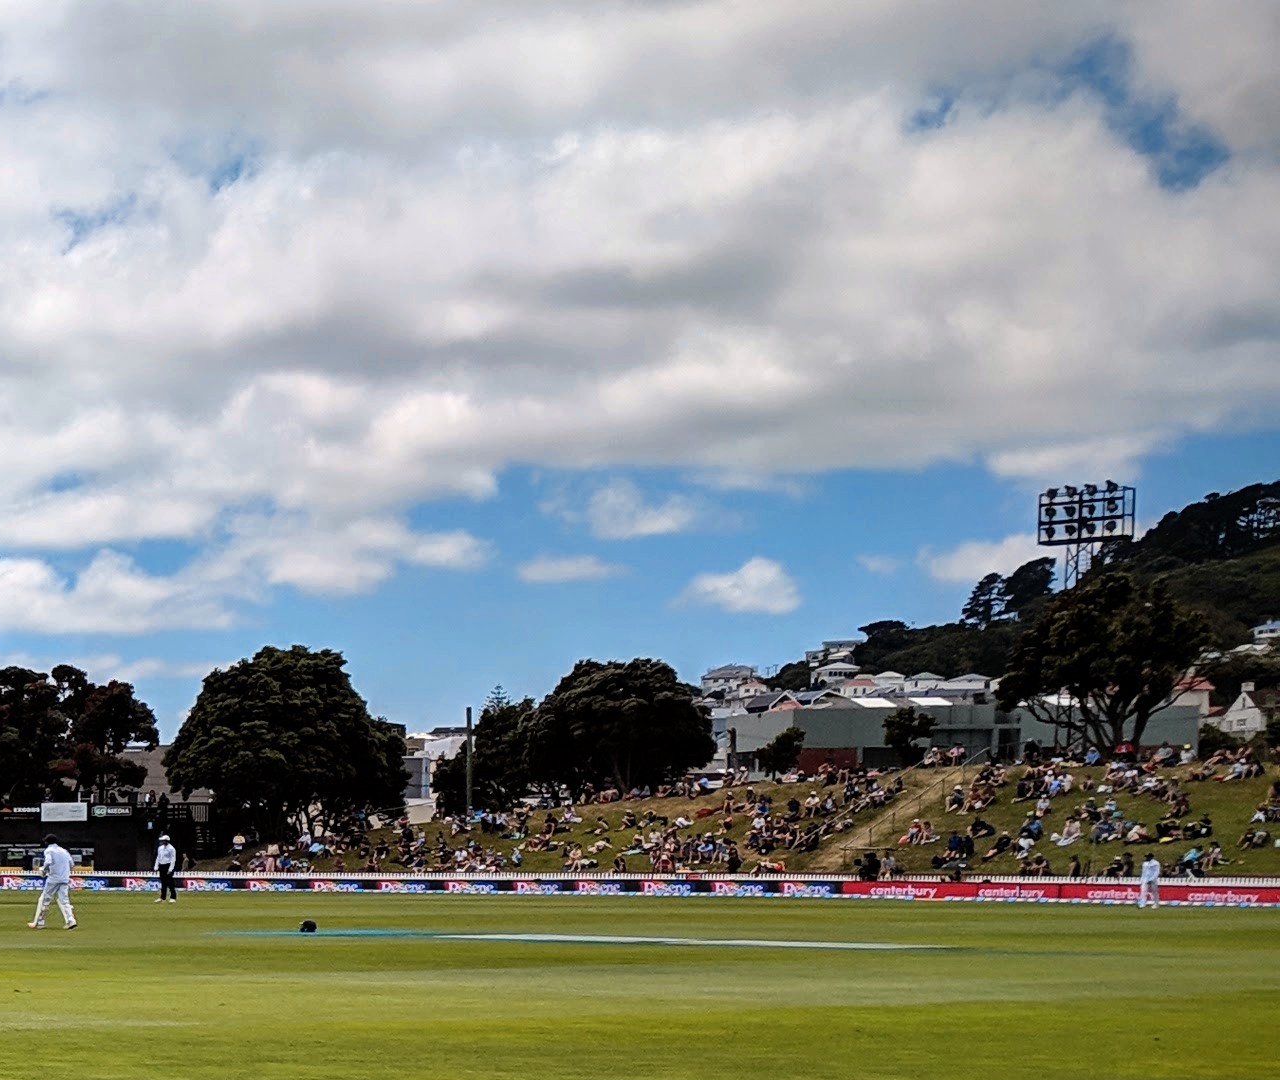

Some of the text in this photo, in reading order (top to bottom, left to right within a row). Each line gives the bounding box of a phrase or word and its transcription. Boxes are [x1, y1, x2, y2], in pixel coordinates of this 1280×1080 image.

[3, 876, 43, 887] Resene
[126, 878, 161, 889] Resen
[186, 879, 228, 890] Resene
[249, 880, 292, 891] Resene
[313, 880, 358, 892] Resene
[381, 881, 426, 892] Resene
[448, 881, 494, 893] Resene
[516, 881, 559, 893] Resene
[578, 881, 621, 893] Resene
[643, 881, 691, 894] Resene
[713, 882, 763, 894] Resene
[783, 882, 830, 894] Resene
[870, 884, 937, 898] canterbury
[1187, 889, 1259, 903] canterbury
